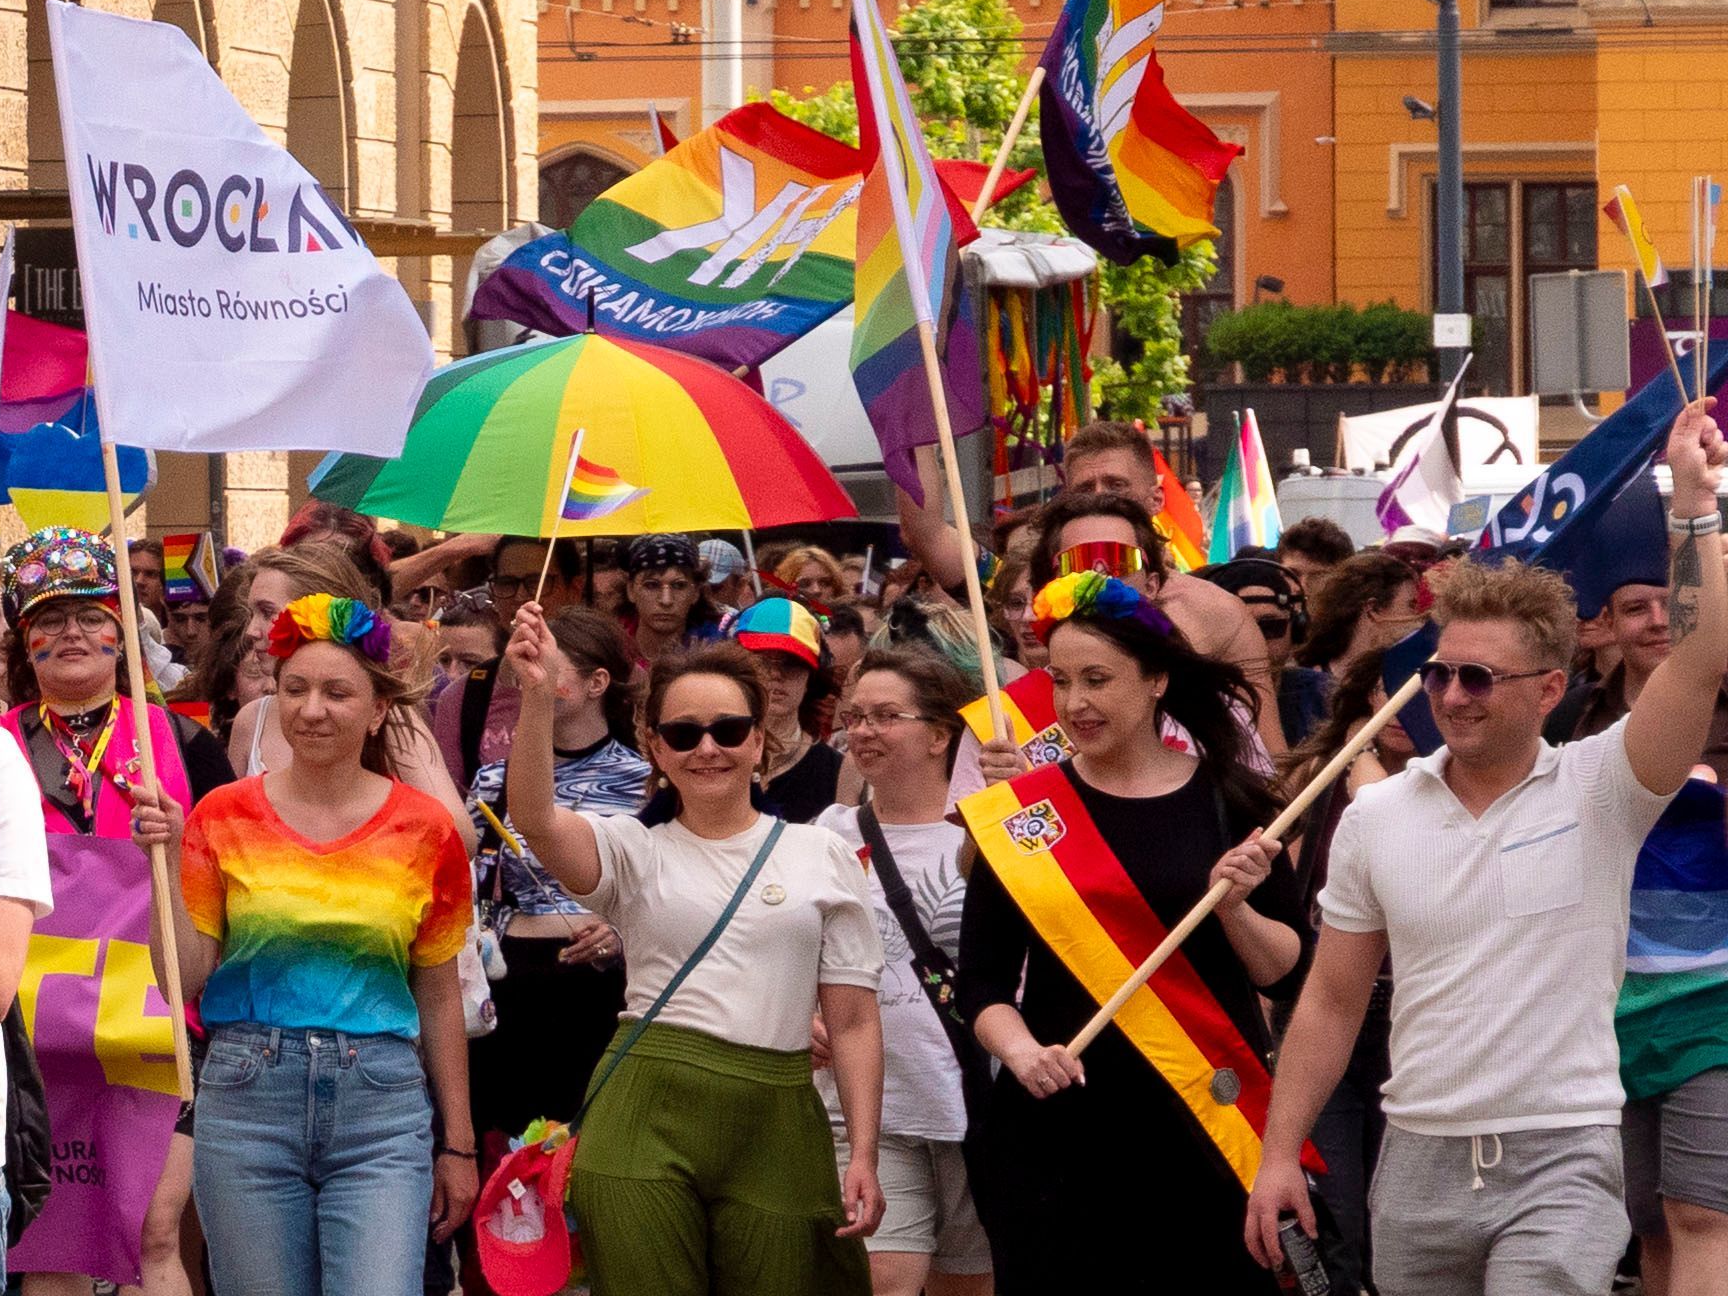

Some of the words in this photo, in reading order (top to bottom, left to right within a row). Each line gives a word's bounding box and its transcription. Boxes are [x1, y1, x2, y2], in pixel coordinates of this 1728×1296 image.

[137, 280, 212, 318] Miasto
[215, 283, 349, 322] Równości
[51, 1140, 97, 1161] URA
